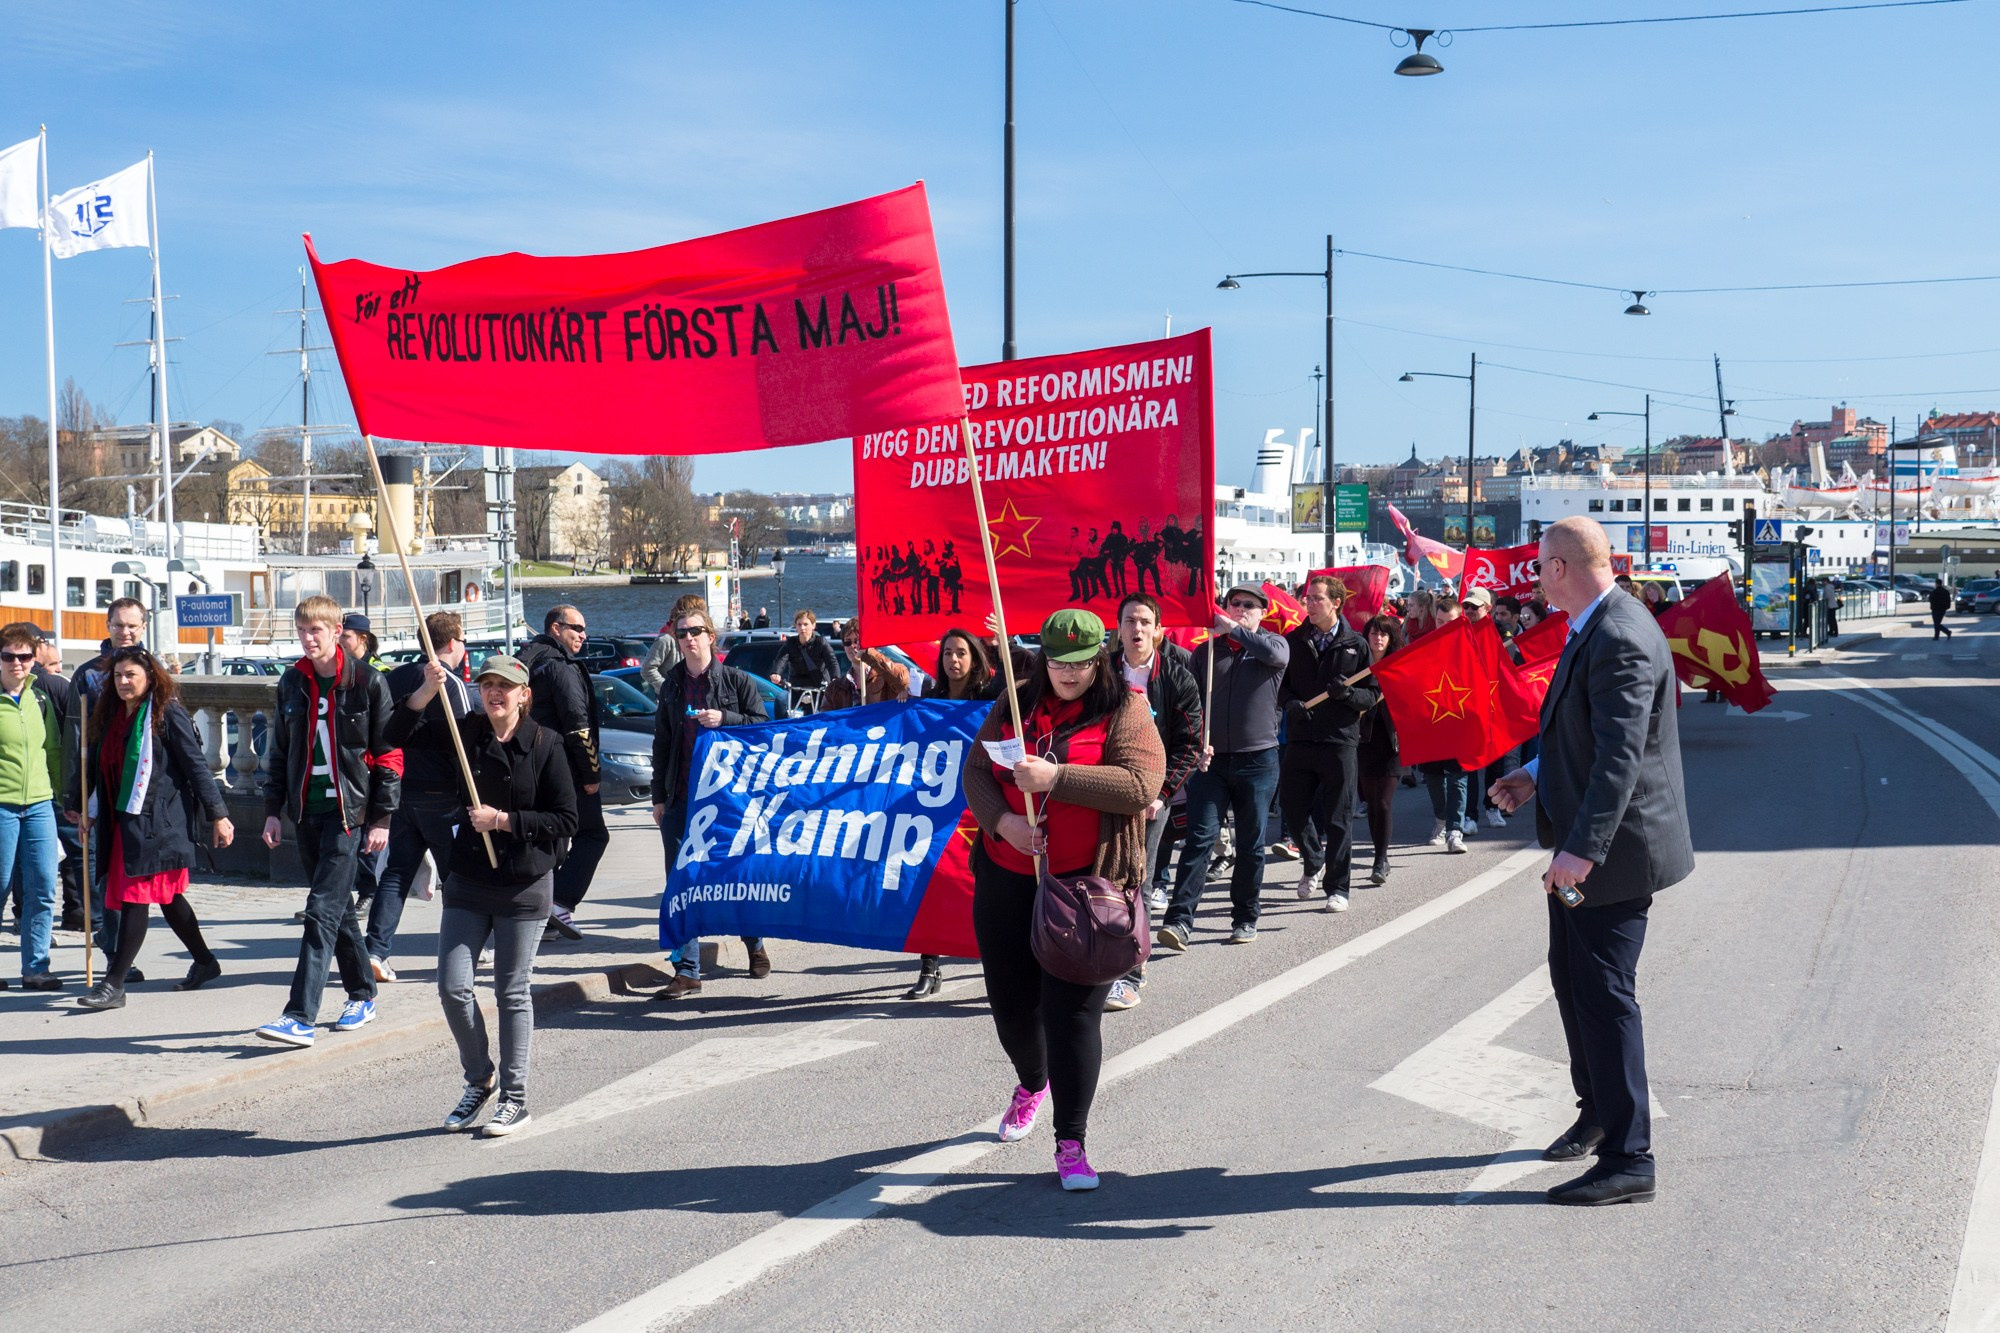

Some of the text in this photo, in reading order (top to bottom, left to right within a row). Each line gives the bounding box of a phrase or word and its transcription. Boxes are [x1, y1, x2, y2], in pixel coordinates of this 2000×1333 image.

[355, 273, 422, 323] För ett
[386, 282, 901, 363] REVOLUTIONÄRT FÖRSTA MAJ!
[961, 355, 1194, 410] ED REFORMISMEN!
[863, 395, 1179, 460] BYGG DEN REVOLUTIONÄRA
[910, 441, 1108, 489] DUBBELMAKTEN!
[1668, 540, 1726, 556] din-Linjen
[180, 600, 227, 610] P-automat
[182, 612, 227, 623] kontokort
[694, 726, 963, 808] Bildning
[676, 791, 933, 890] & Kamp
